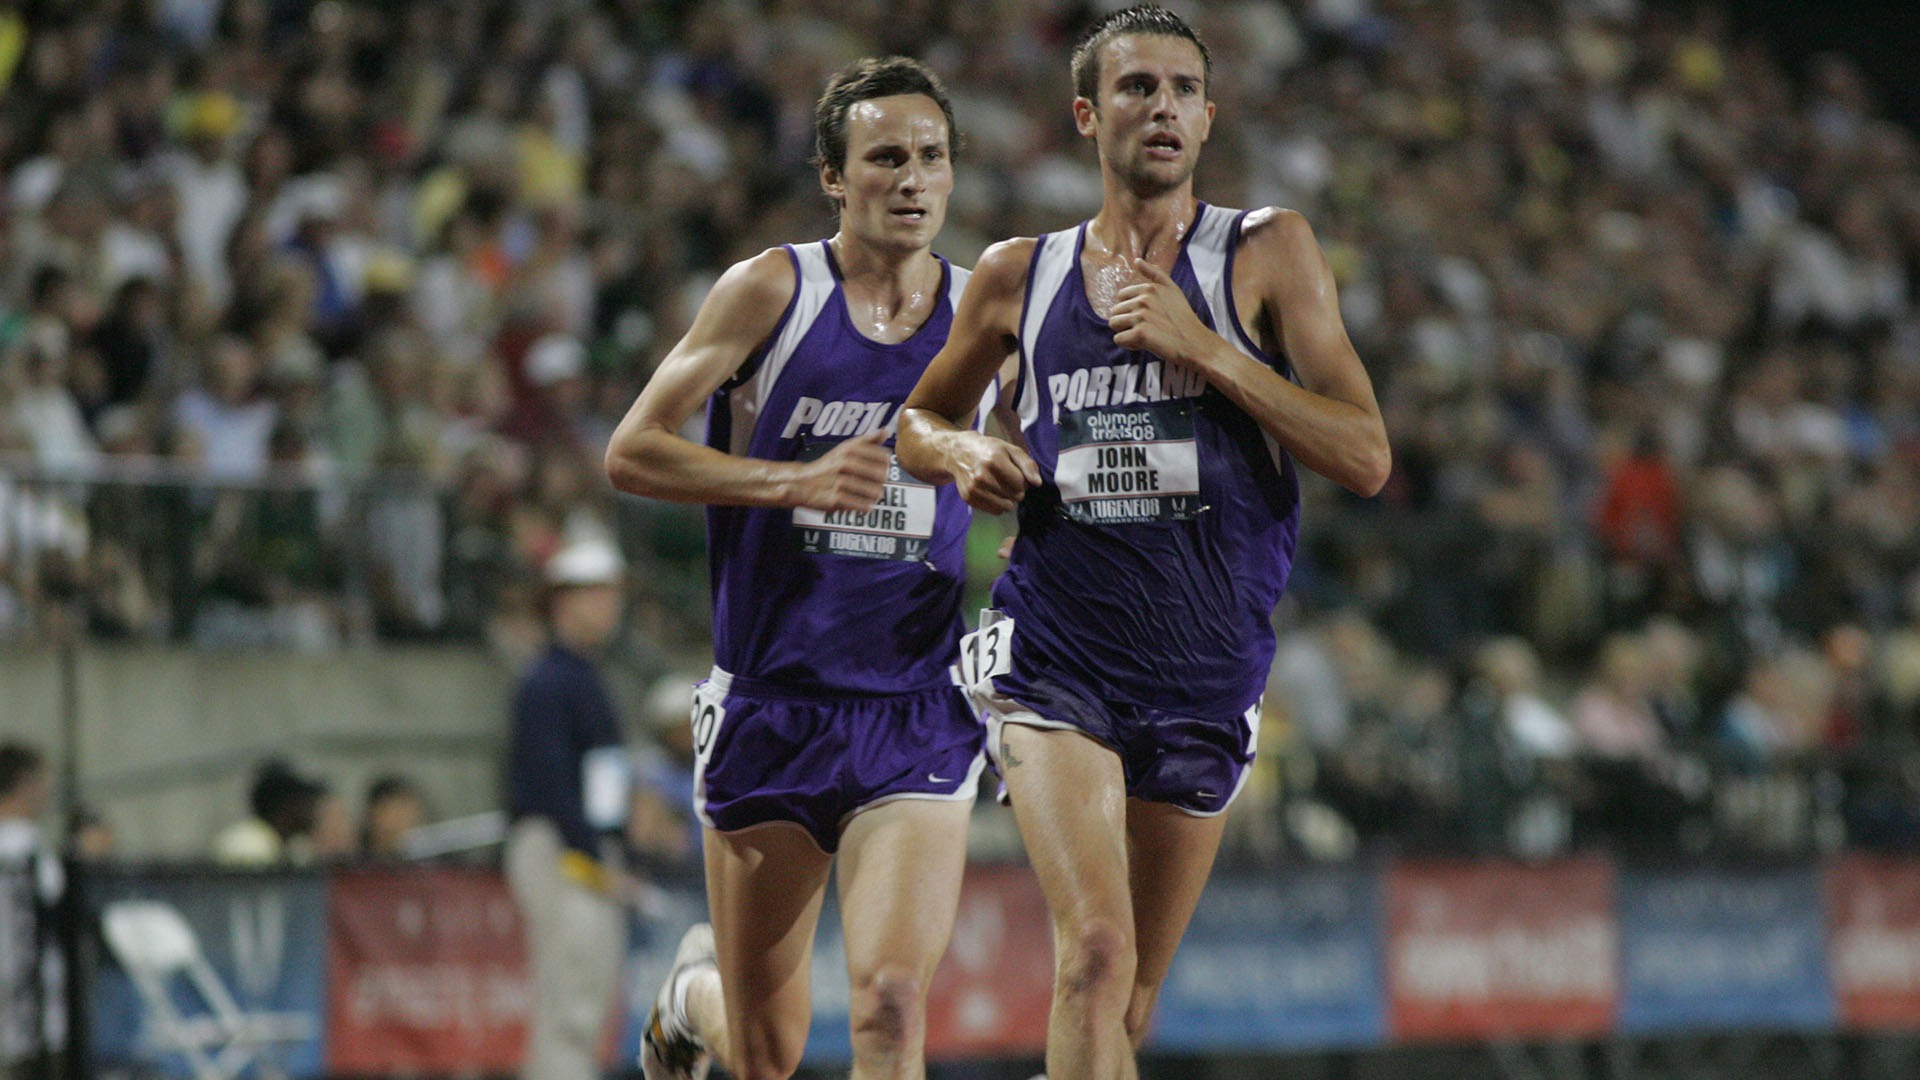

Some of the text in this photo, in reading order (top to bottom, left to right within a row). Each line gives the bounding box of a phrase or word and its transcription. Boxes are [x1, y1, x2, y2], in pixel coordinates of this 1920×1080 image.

[1048, 361, 1205, 424] PORTLAND
[1087, 408, 1150, 430] olympic
[1096, 446, 1147, 469] JOHN
[1087, 470, 1159, 493] MOORE
[1088, 498, 1160, 519] EUGENE08
[967, 627, 999, 684] 13
